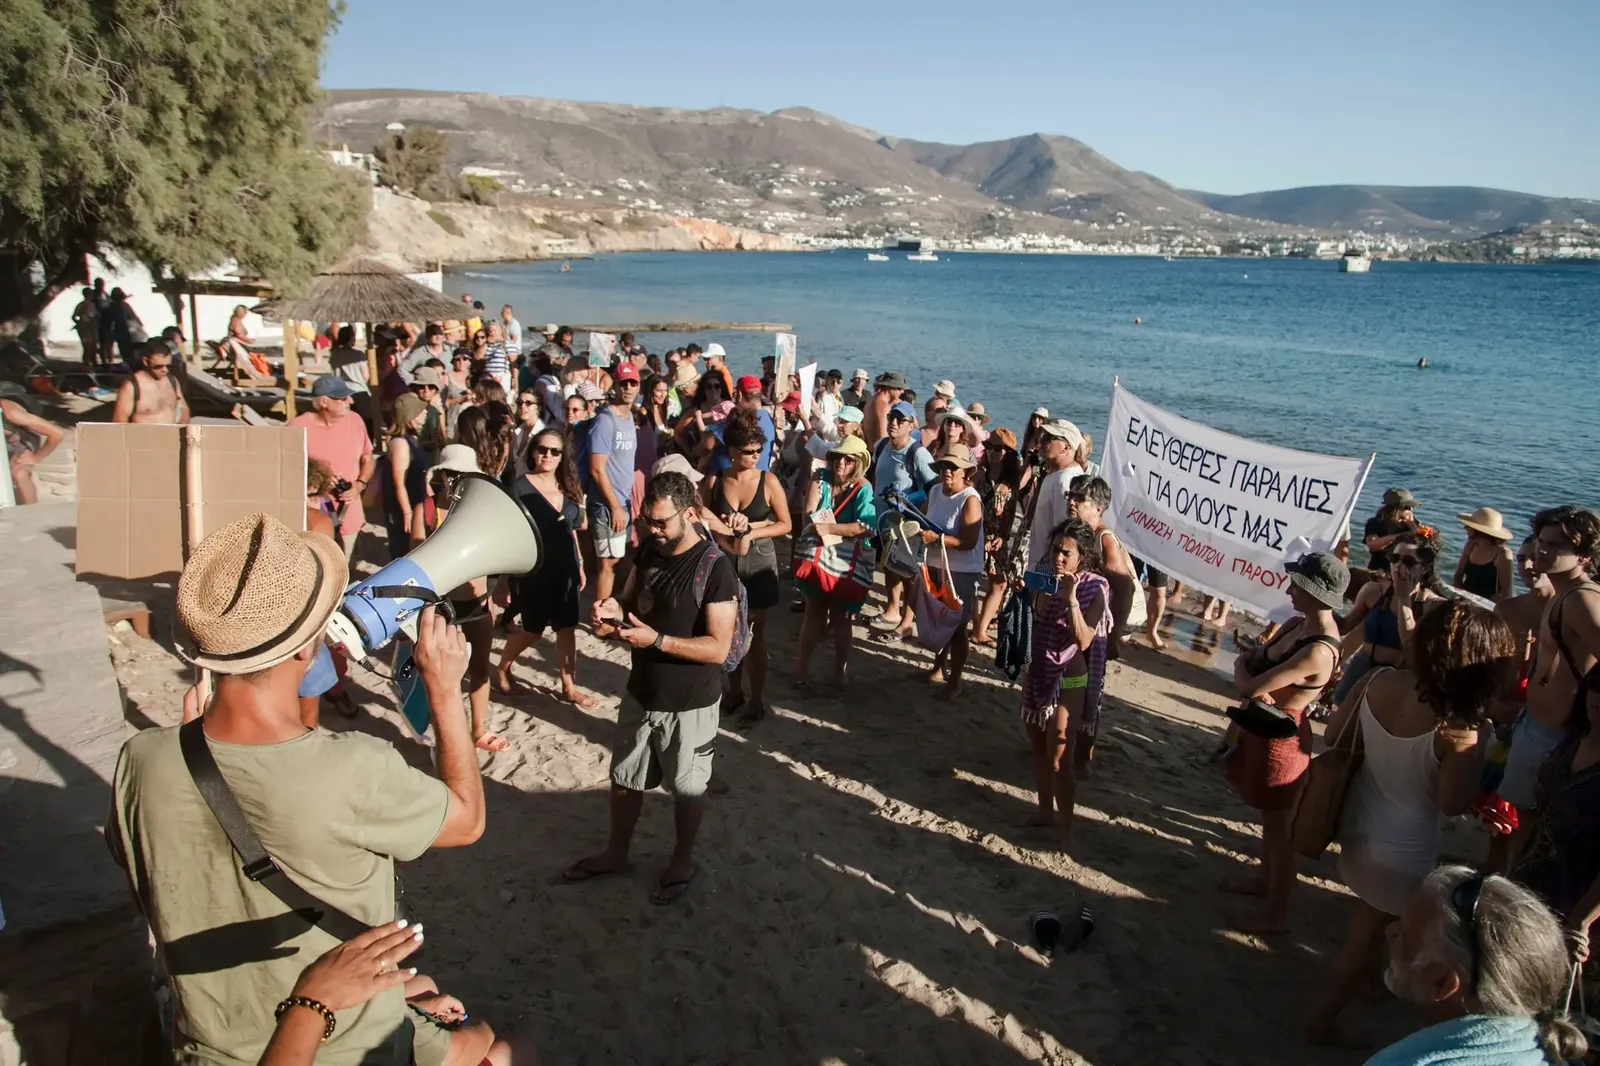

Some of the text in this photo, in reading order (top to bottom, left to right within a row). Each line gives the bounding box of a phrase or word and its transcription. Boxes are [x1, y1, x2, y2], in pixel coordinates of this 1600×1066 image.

[1126, 416, 1339, 515] ΕΛΕΥΘΕΡΕΣ ΠΑΡΑΛΙΕΣ
[1126, 507, 1289, 590] ΚΙΝΗΣΗ ΠΟΛΙΤΩΝ ΠΑΡΟΥ
[1147, 470, 1288, 552] ΓΙΑ ΟΛΟΥΣ ΜΑΣ
